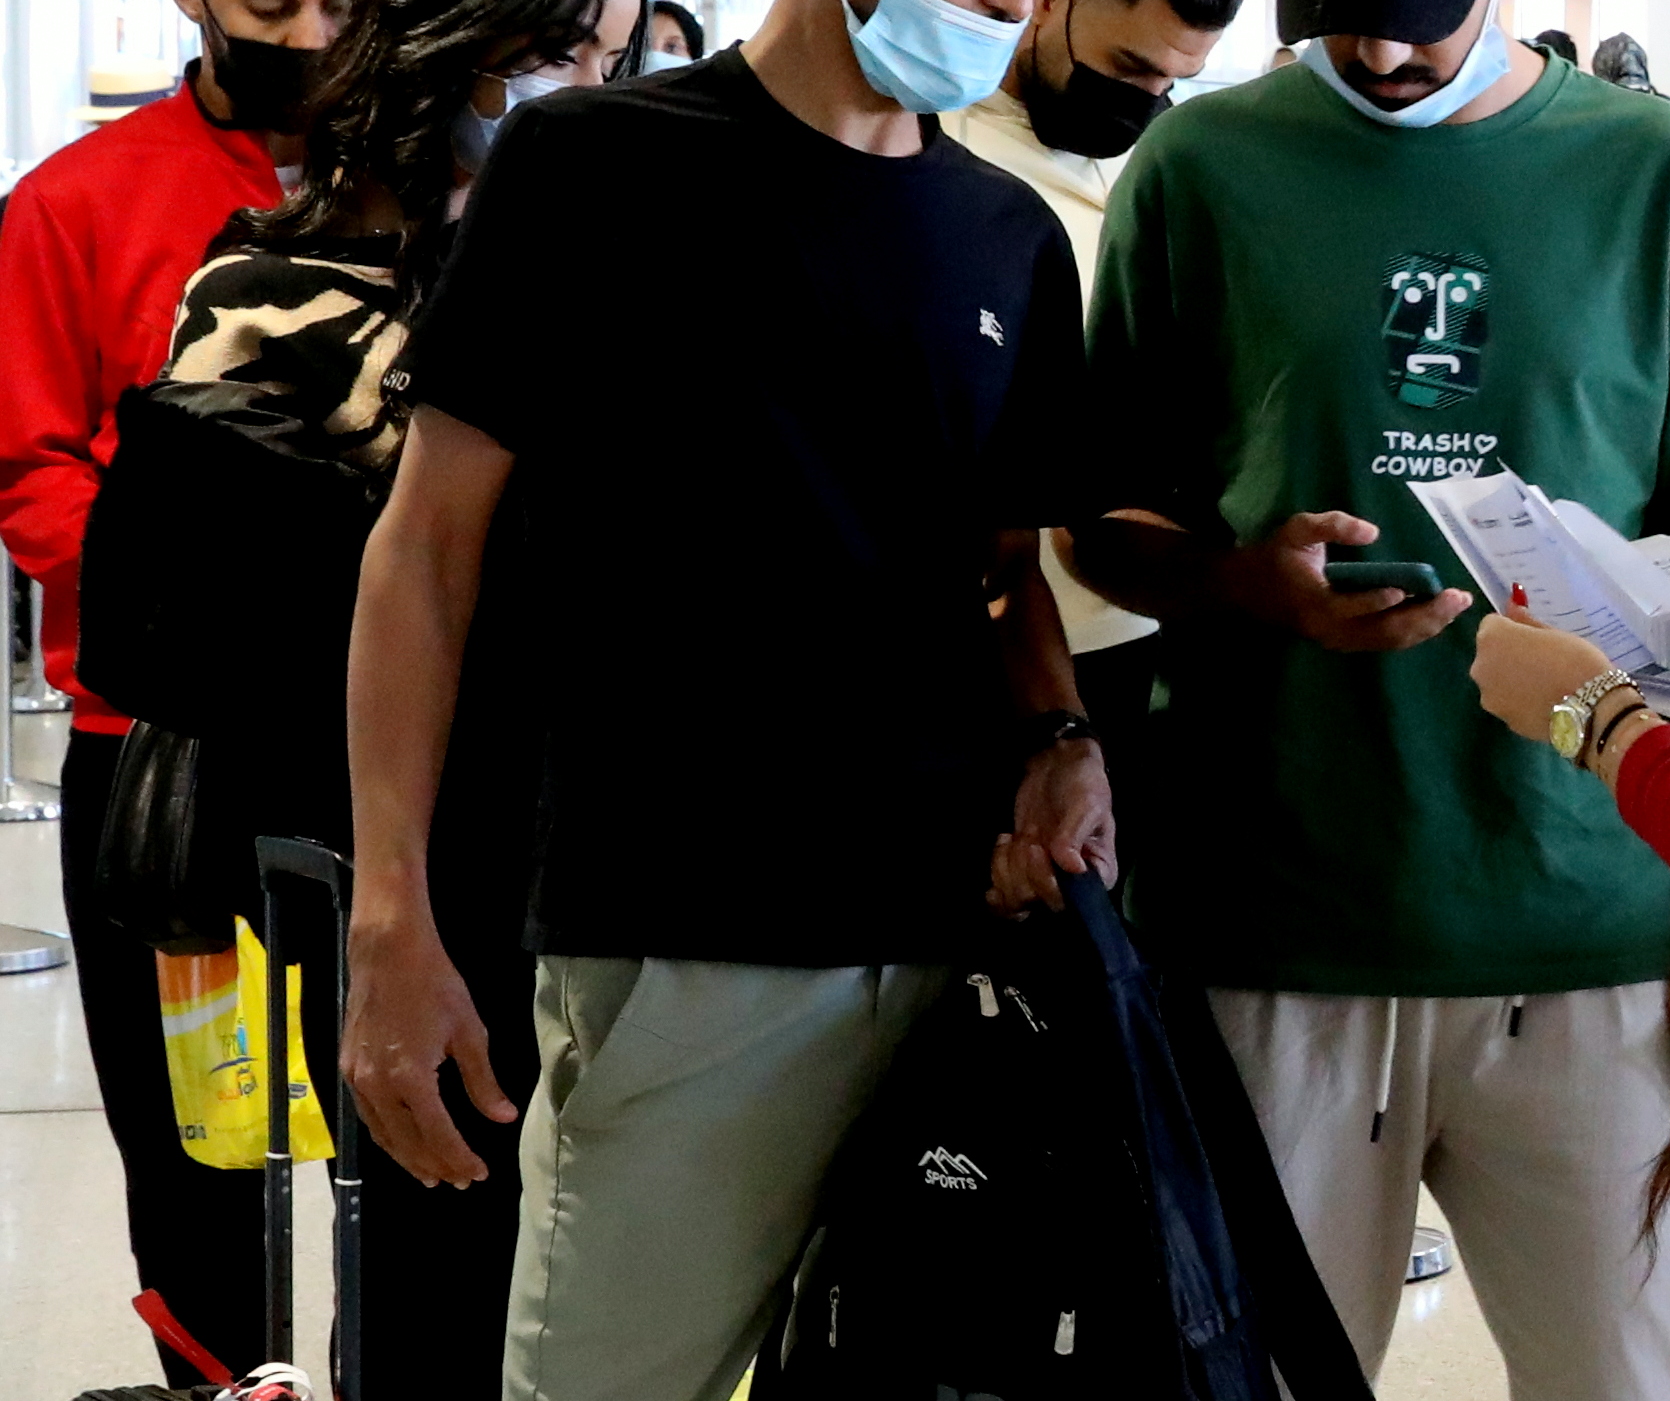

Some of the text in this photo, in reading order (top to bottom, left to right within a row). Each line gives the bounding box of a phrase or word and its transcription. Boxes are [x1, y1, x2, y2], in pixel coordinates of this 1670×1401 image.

[1382, 430, 1471, 453] TRASH
[1371, 454, 1485, 477] COWBOY
[924, 1168, 978, 1190] SPORTS
